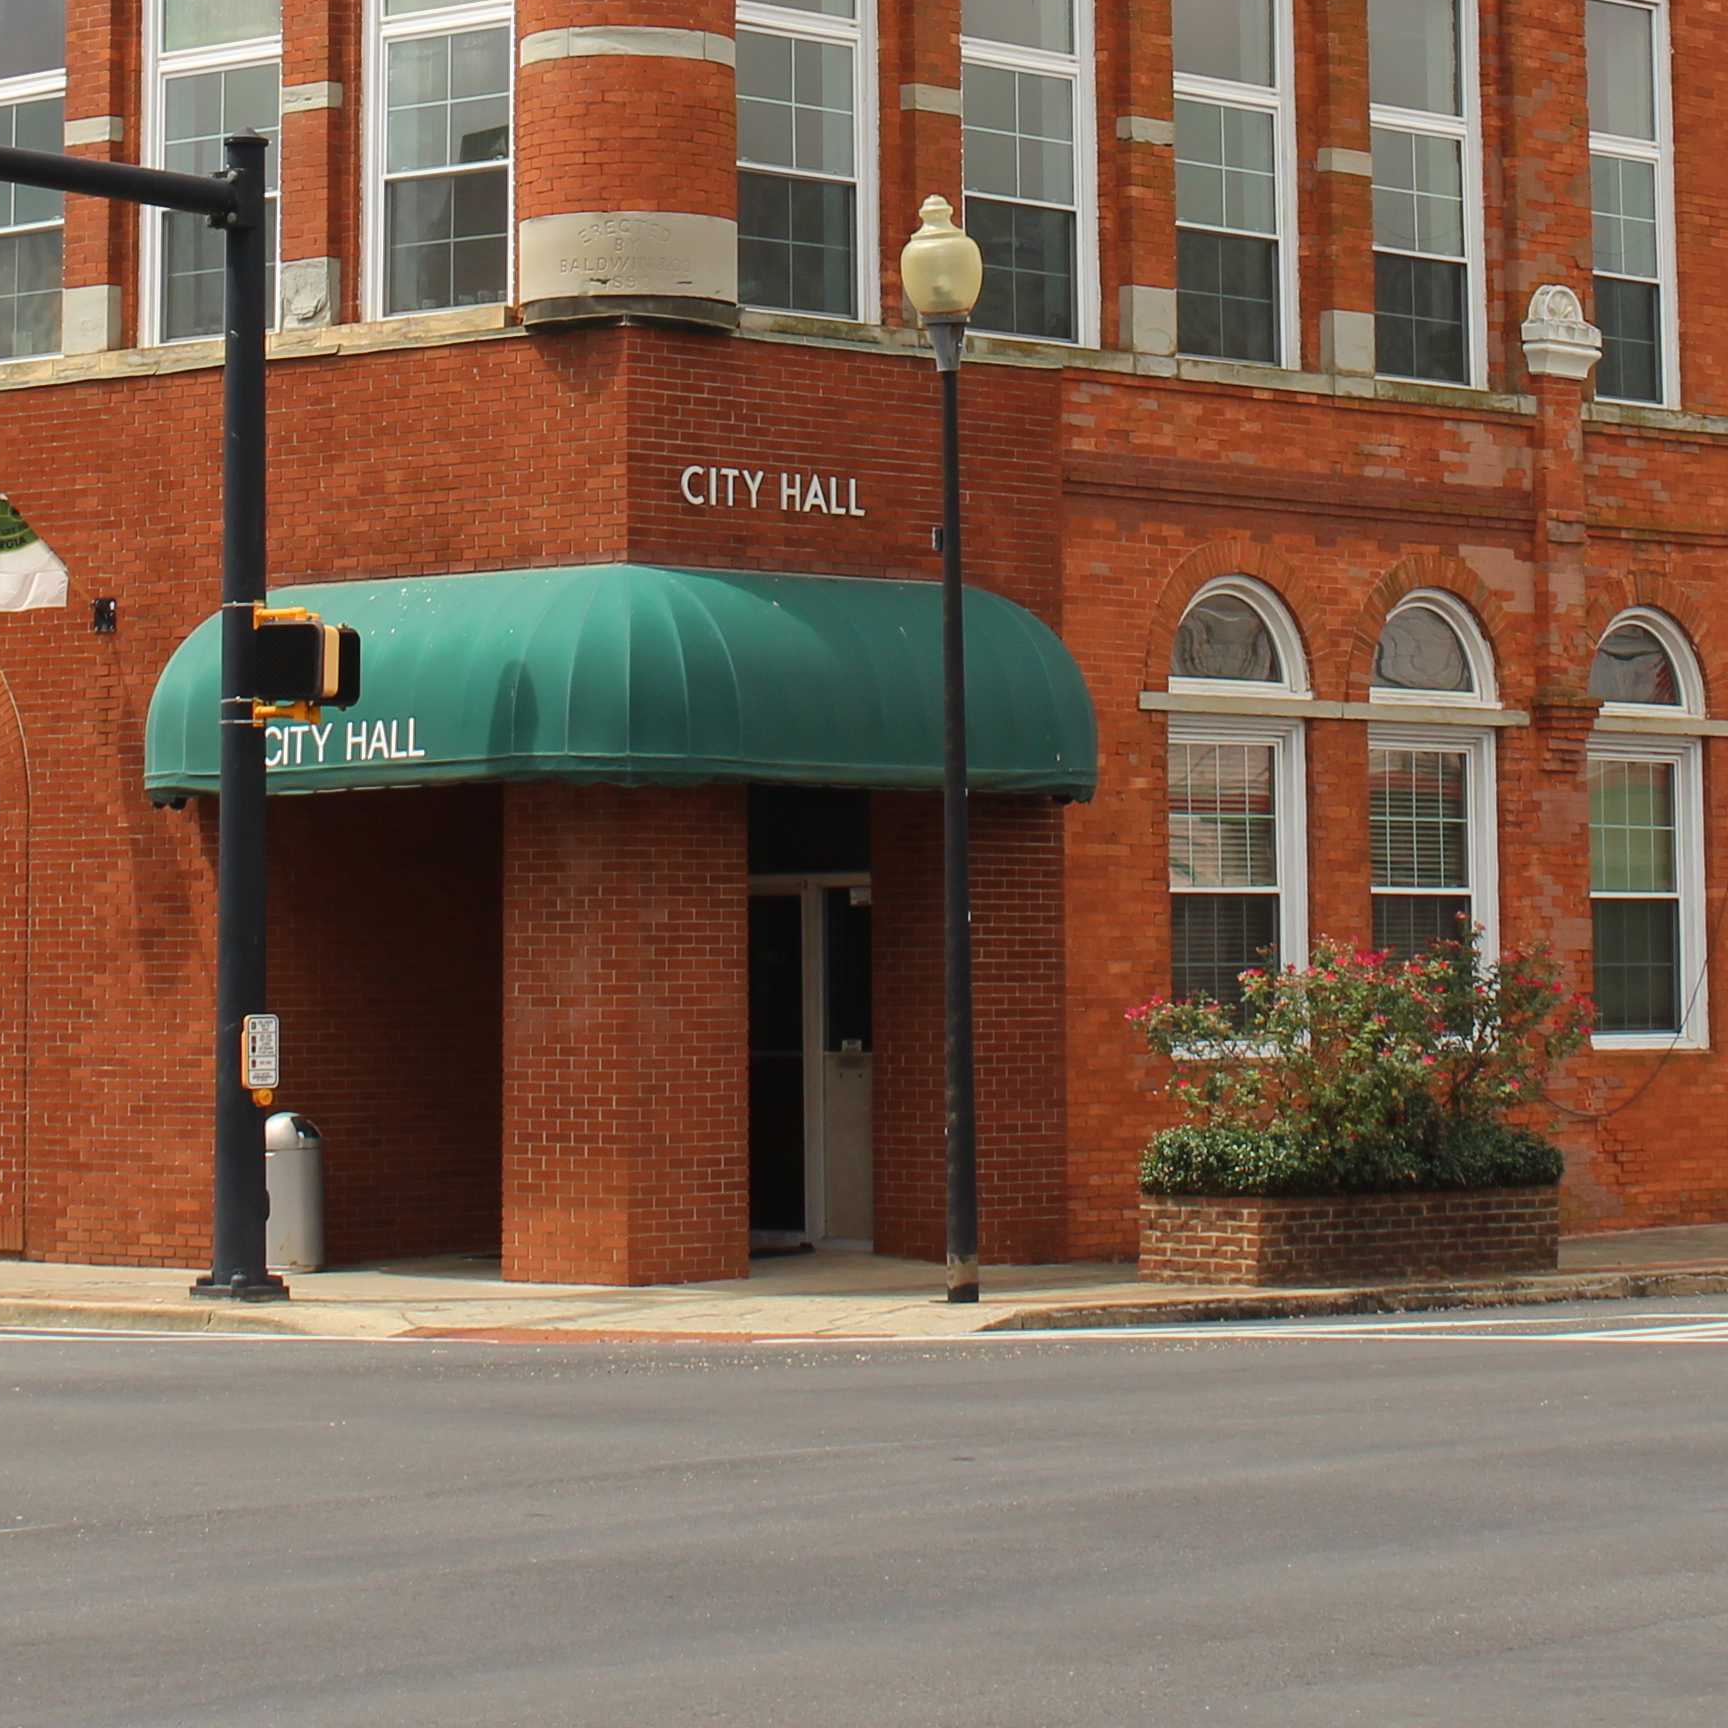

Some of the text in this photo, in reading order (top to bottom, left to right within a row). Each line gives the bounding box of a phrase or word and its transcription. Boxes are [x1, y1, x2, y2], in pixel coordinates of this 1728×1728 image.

[578, 218, 671, 246] ERECTED
[615, 237, 640, 253] BY
[560, 256, 652, 275] BALDWIN
[680, 465, 866, 517] CITY HALL
[265, 717, 426, 767] CITY HALL
